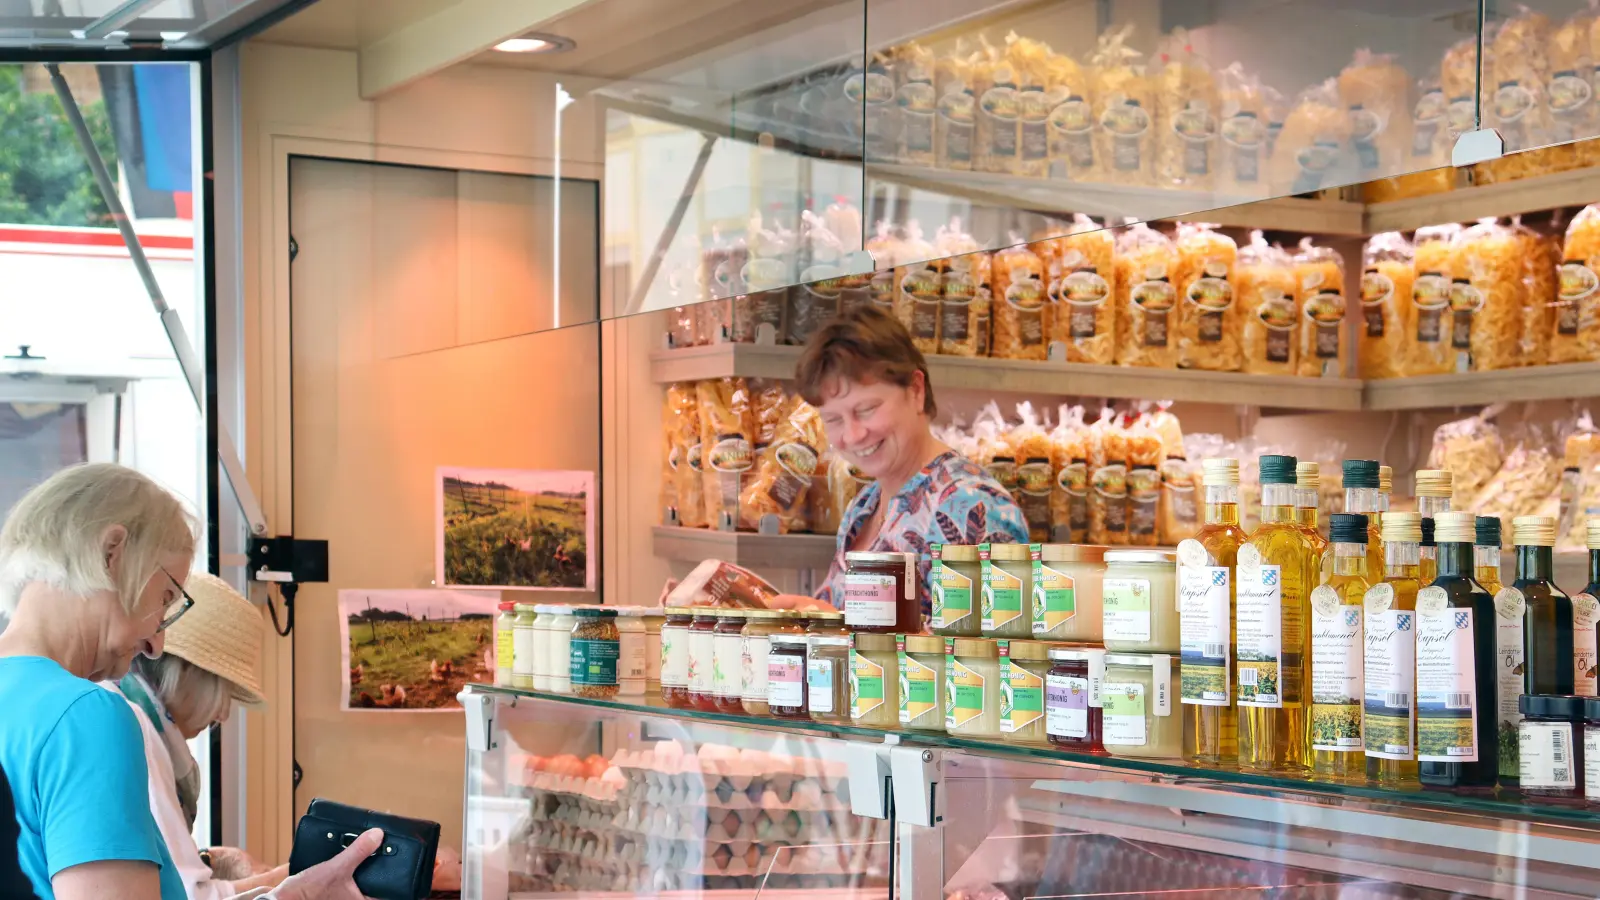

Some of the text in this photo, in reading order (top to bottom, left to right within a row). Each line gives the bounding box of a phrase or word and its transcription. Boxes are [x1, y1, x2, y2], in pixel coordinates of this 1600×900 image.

[1415, 628, 1456, 647] Rapsöl
[1505, 655, 1516, 668] Öl
[1577, 657, 1588, 671] Öl
[1008, 672, 1025, 680] HONIG
